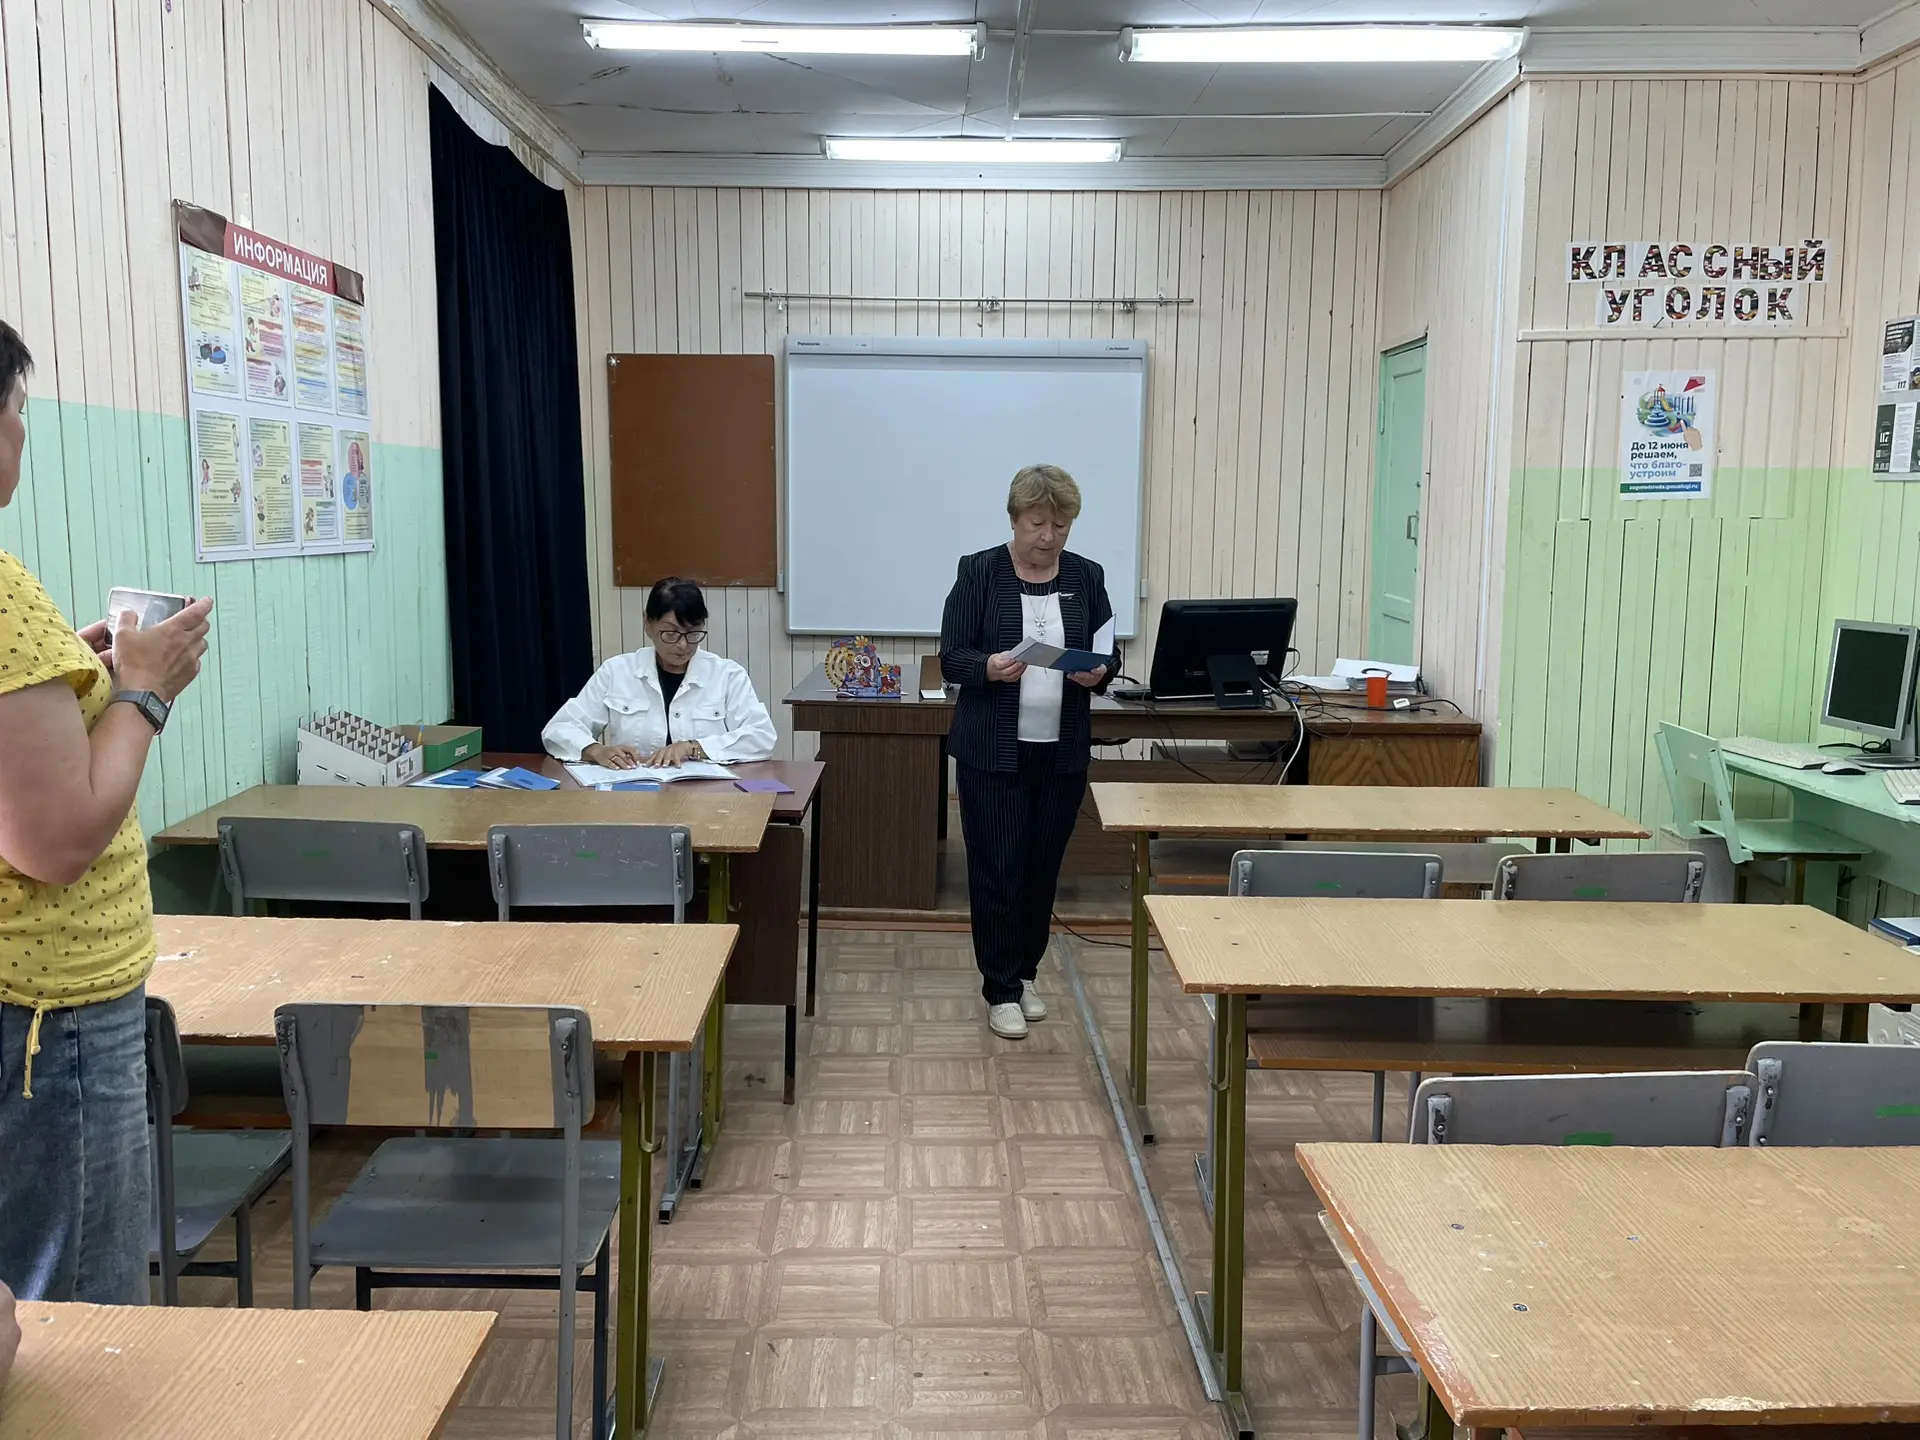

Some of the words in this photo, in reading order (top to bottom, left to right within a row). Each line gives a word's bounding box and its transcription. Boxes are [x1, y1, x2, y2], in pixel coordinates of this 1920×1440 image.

[233, 231, 328, 287] ИНФОРМАЦИЯ
[1571, 240, 1826, 281] КЛАССНЫЙ
[1604, 286, 1793, 323] УГОЛОК
[1631, 442, 1646, 451] До
[1648, 442, 1658, 450] 12
[1631, 451, 1677, 461] решаем,
[1652, 460, 1687, 469] благо-
[1630, 470, 1676, 479] устроим
